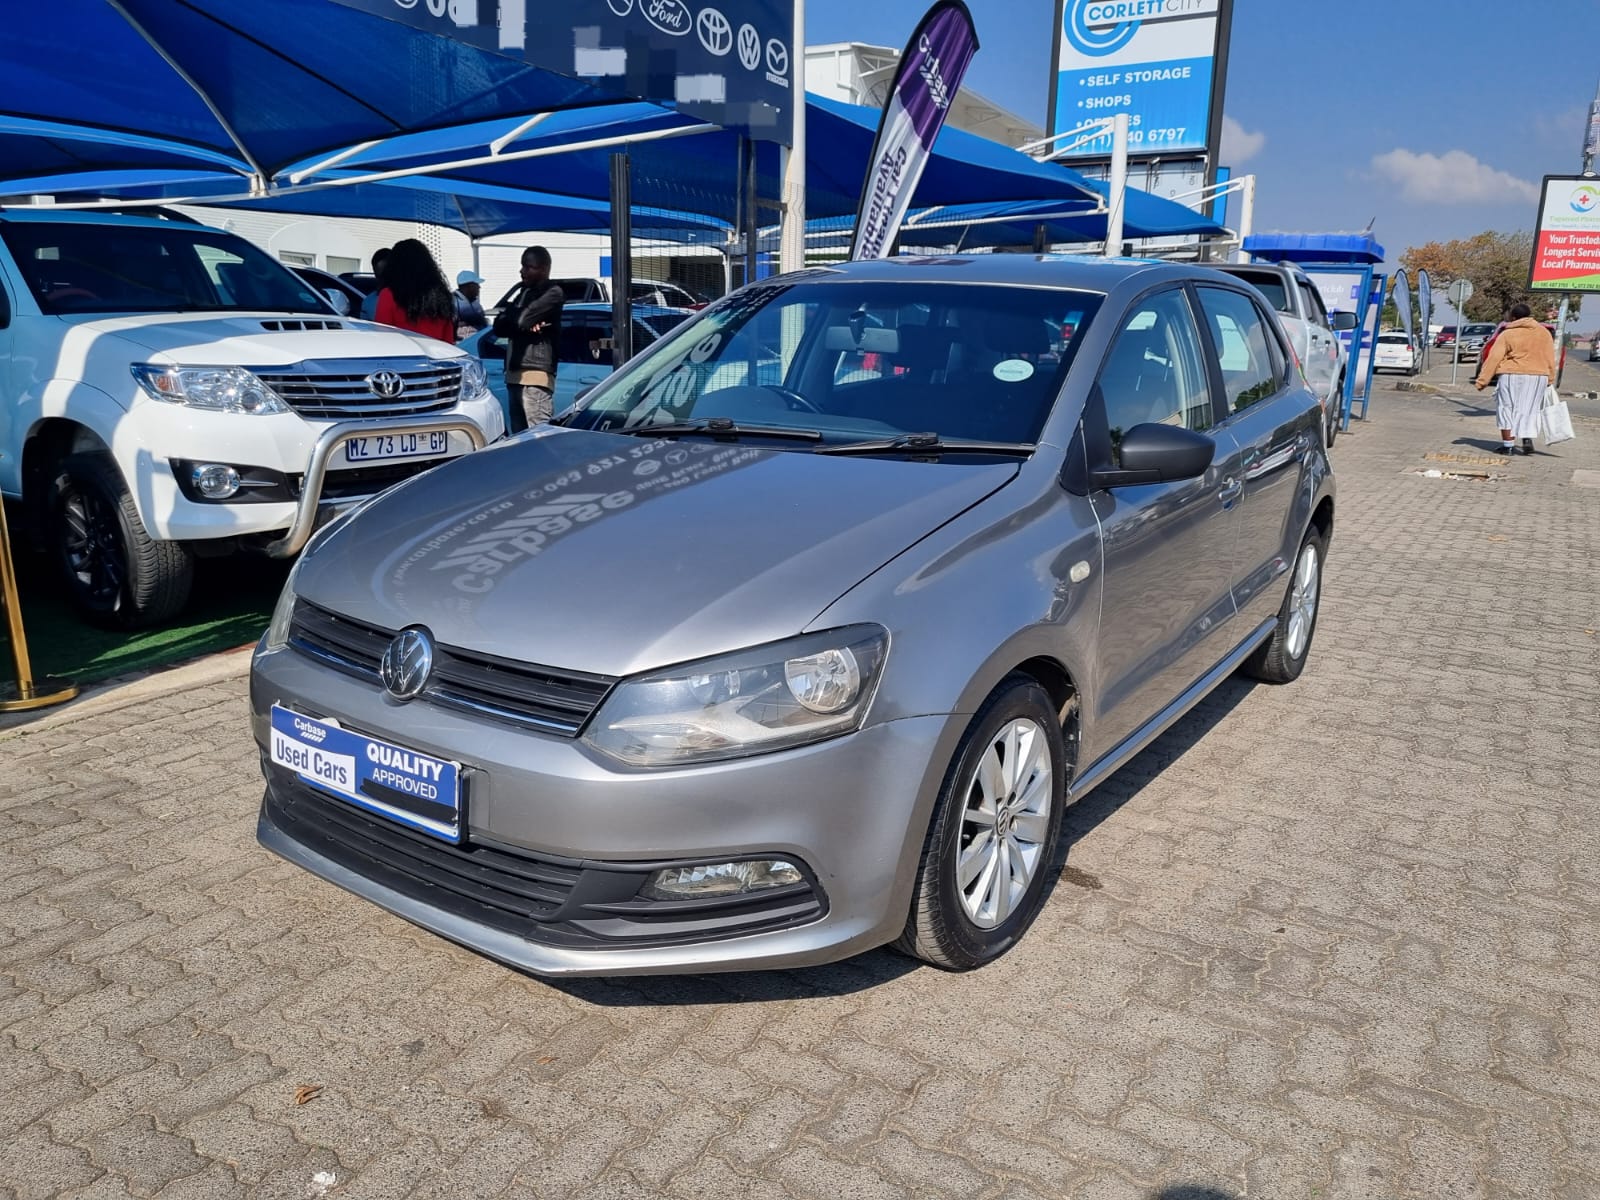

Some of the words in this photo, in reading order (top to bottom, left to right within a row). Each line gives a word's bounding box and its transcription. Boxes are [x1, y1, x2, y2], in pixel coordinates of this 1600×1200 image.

[648, 0, 682, 28] Ford
[1088, 0, 1163, 20] CORLETT
[1087, 73, 1120, 87] SELF
[1124, 66, 1191, 84] STORAGE
[1085, 95, 1132, 109] SHOPS
[1149, 127, 1186, 142] 6797
[890, 146, 908, 188] Car
[1549, 233, 1567, 245] Your
[1543, 246, 1576, 259] Longest
[1577, 247, 1600, 258] Servi
[1542, 258, 1564, 269] Local
[350, 438, 369, 457] MZ
[376, 436, 394, 455] 73
[400, 433, 417, 453] LD
[430, 431, 445, 451] GP
[294, 718, 327, 739] Carbase
[275, 736, 309, 769] Used
[313, 752, 347, 785] Cars
[366, 742, 444, 782] QUALITY
[371, 767, 438, 800] APPROVED
